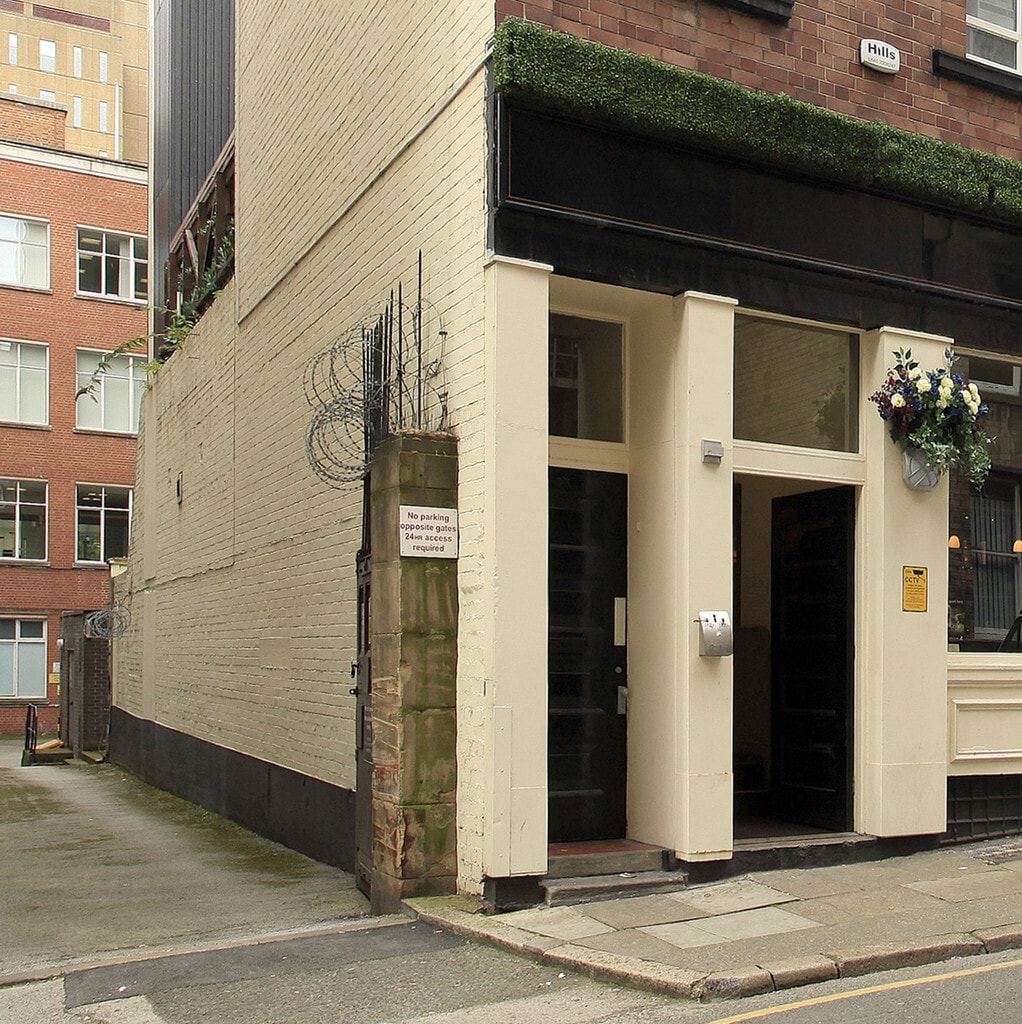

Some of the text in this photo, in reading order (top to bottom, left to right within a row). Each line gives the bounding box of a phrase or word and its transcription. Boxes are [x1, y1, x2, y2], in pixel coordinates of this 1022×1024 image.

[868, 43, 896, 60] Hills
[407, 512, 450, 523] No parking
[400, 523, 456, 533] opposite gates
[405, 533, 423, 541] 24HR
[412, 544, 445, 552] required
